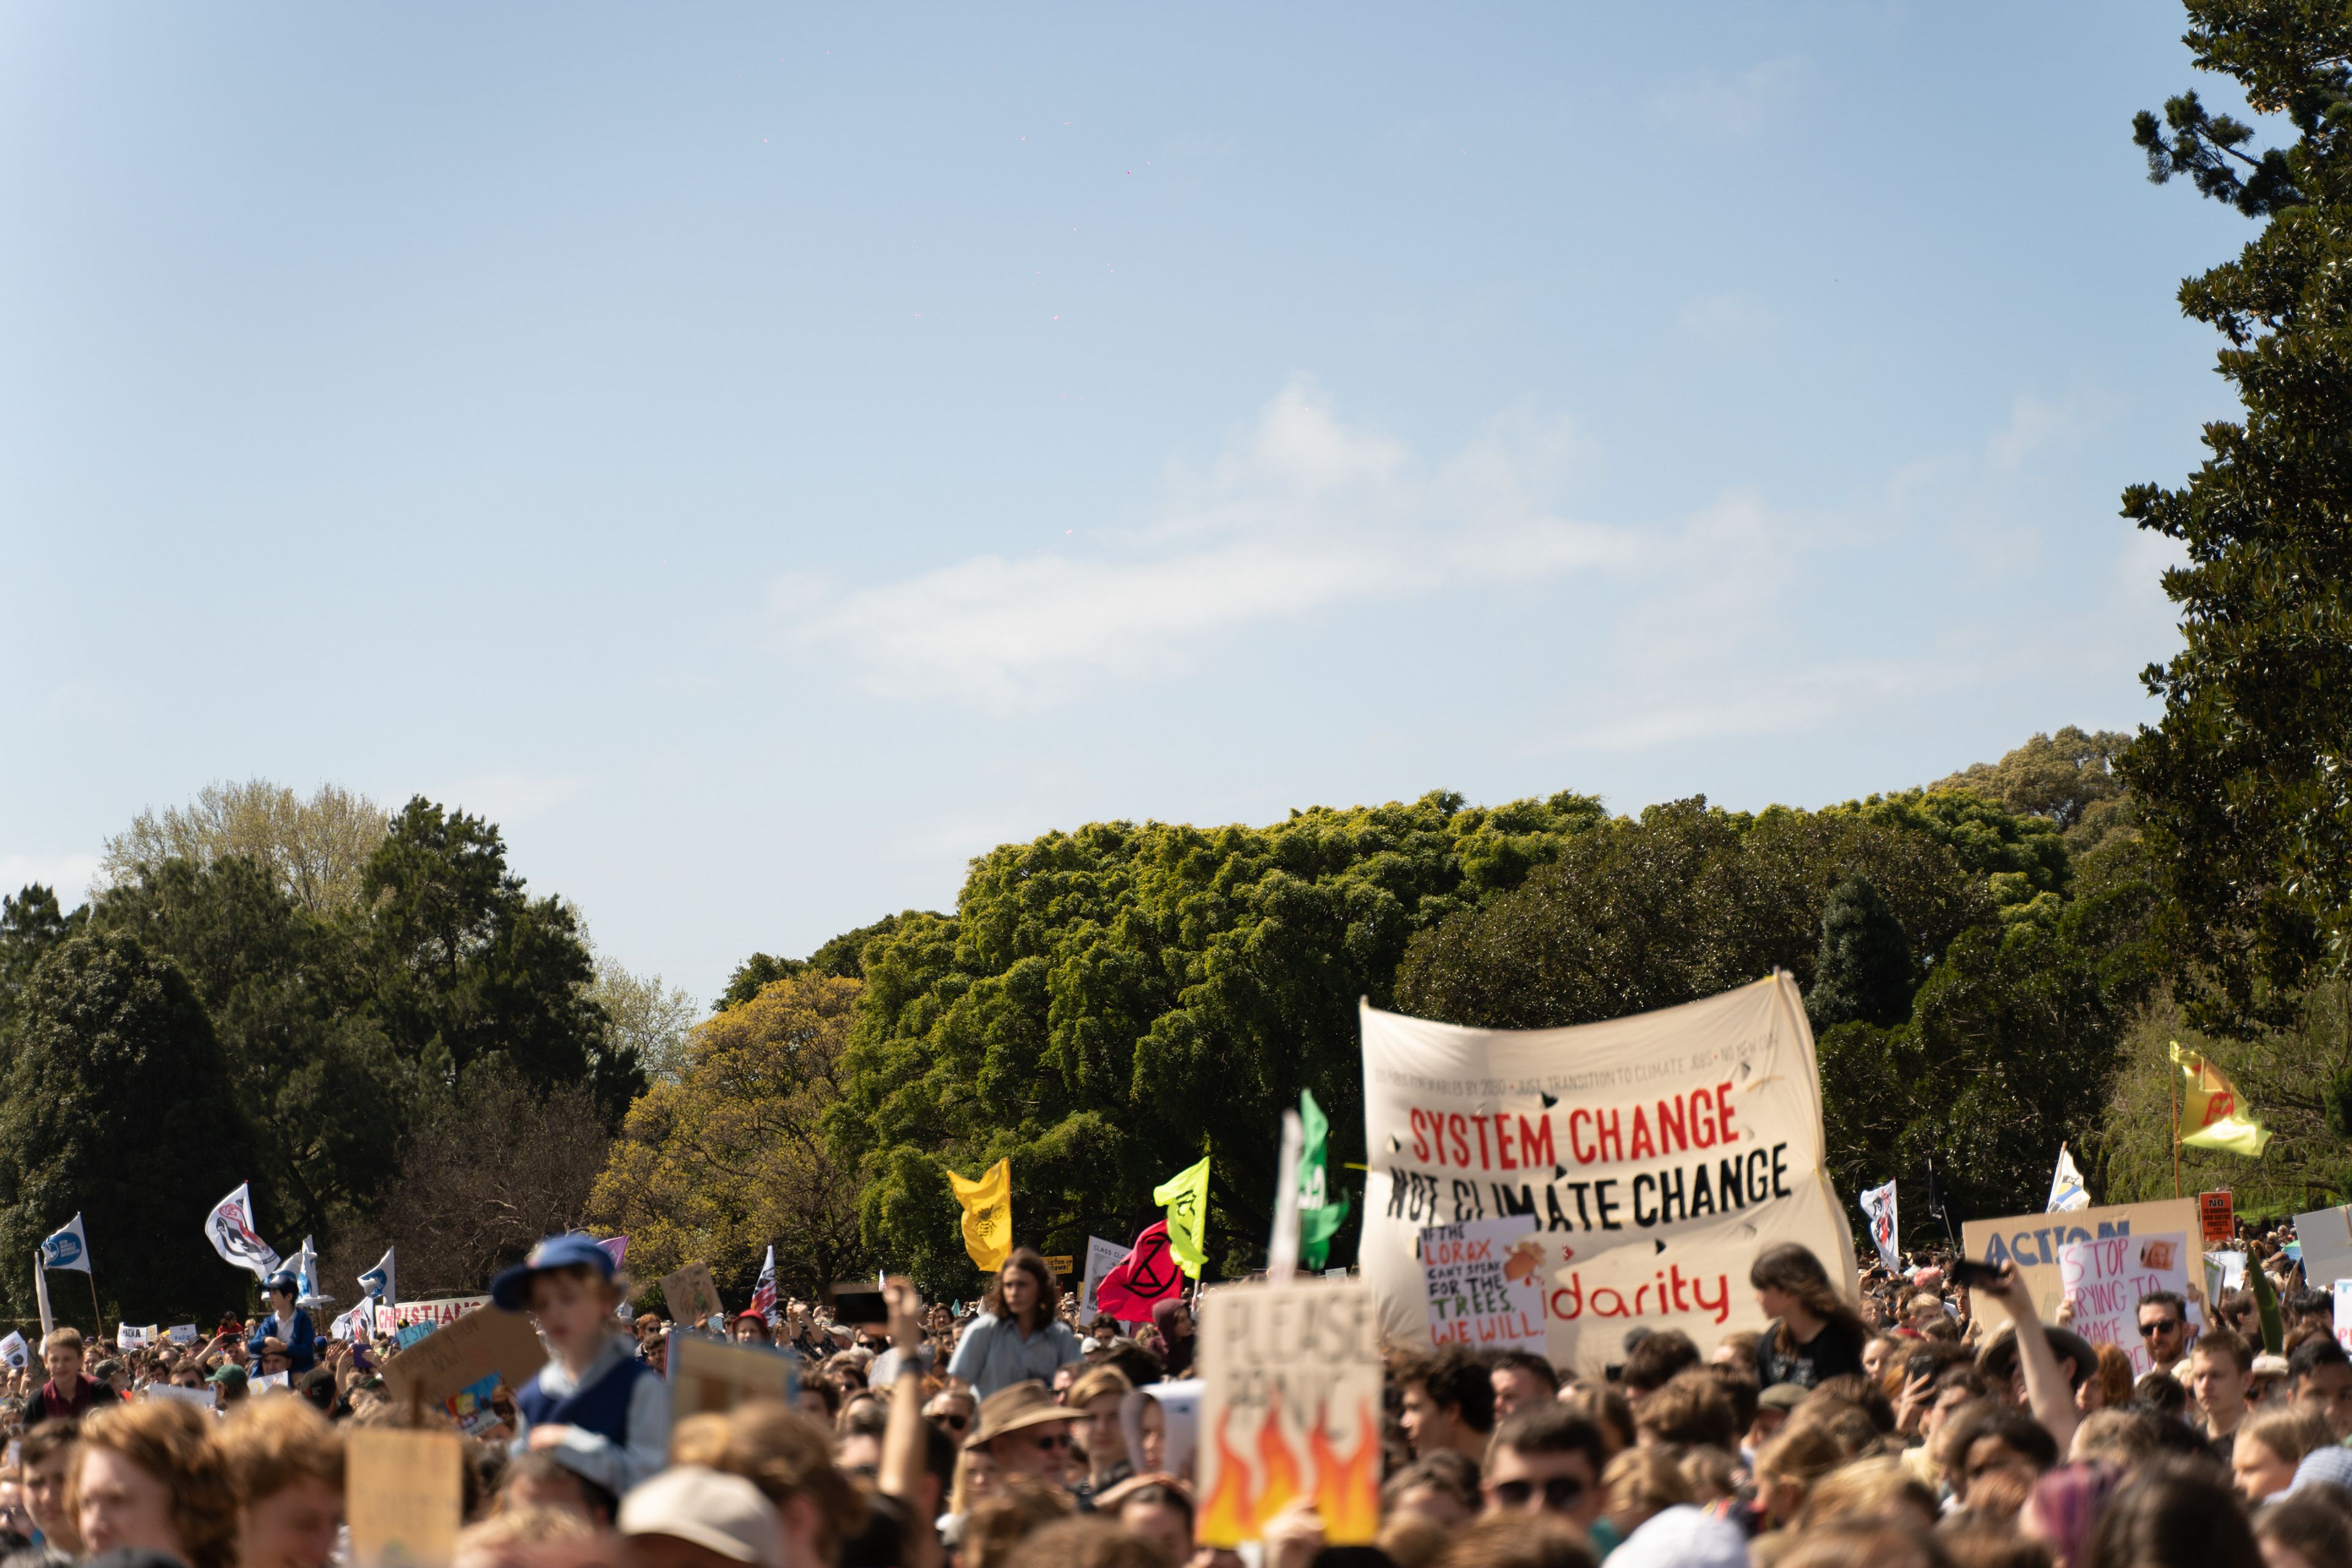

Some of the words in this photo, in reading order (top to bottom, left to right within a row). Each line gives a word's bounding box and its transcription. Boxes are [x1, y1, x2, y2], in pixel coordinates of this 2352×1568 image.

[1548, 1071, 1616, 1094] TRANSITION
[1618, 1067, 1632, 1085] TO
[1634, 1057, 1686, 1083] CLIMATE
[1411, 1107, 1557, 1170] SYSTEM
[1569, 1082, 1740, 1165] CHANGE
[1387, 1166, 1438, 1225] NOT
[1453, 1178, 1623, 1232] CLIMATE
[1632, 1142, 1792, 1228] CHANGE
[2209, 1199, 2224, 1207] NO
[1423, 1229, 1433, 1242] IF
[1438, 1226, 1465, 1240] THE
[1093, 1245, 1112, 1256] CLASS
[1114, 1251, 1126, 1260] CLO
[1424, 1238, 1492, 1265] LORAX
[2065, 1238, 2128, 1283] STOP
[1467, 1261, 1501, 1275] SPEAK
[1430, 1279, 1460, 1296] FOR
[1464, 1274, 1503, 1294] THE
[1430, 1321, 1472, 1347] WE
[2076, 1317, 2124, 1346] MAKE
